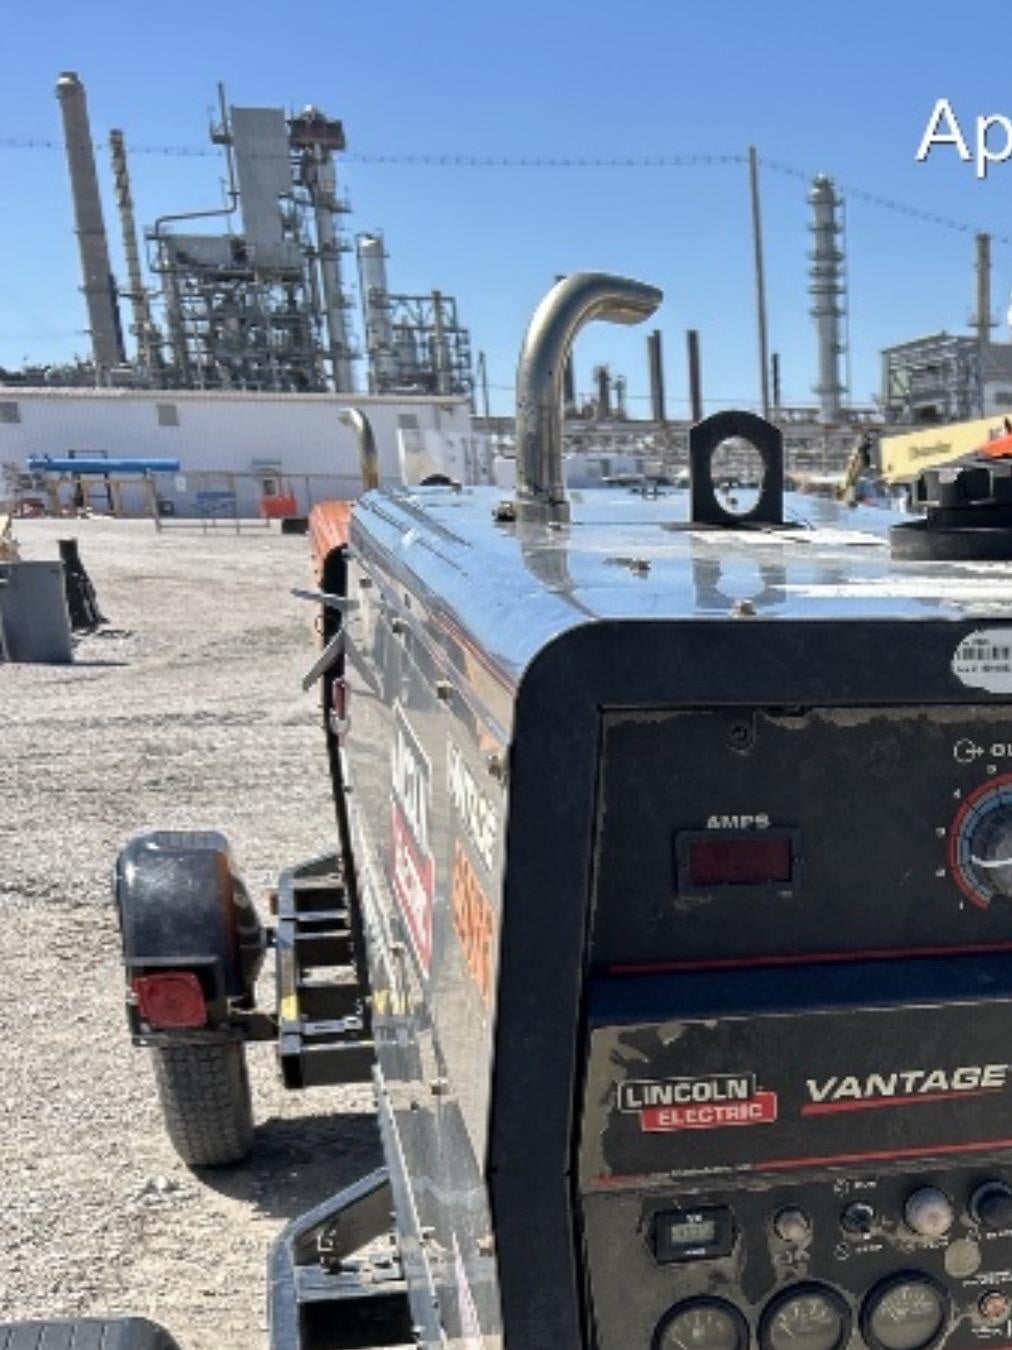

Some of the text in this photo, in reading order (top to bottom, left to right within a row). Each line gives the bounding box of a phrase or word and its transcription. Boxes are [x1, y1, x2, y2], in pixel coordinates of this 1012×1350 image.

[706, 813, 770, 830] AMPS
[625, 1078, 749, 1109] LINCOLN
[805, 1063, 1009, 1102] VANTAGE
[657, 1102, 763, 1127] ELECTRIC
